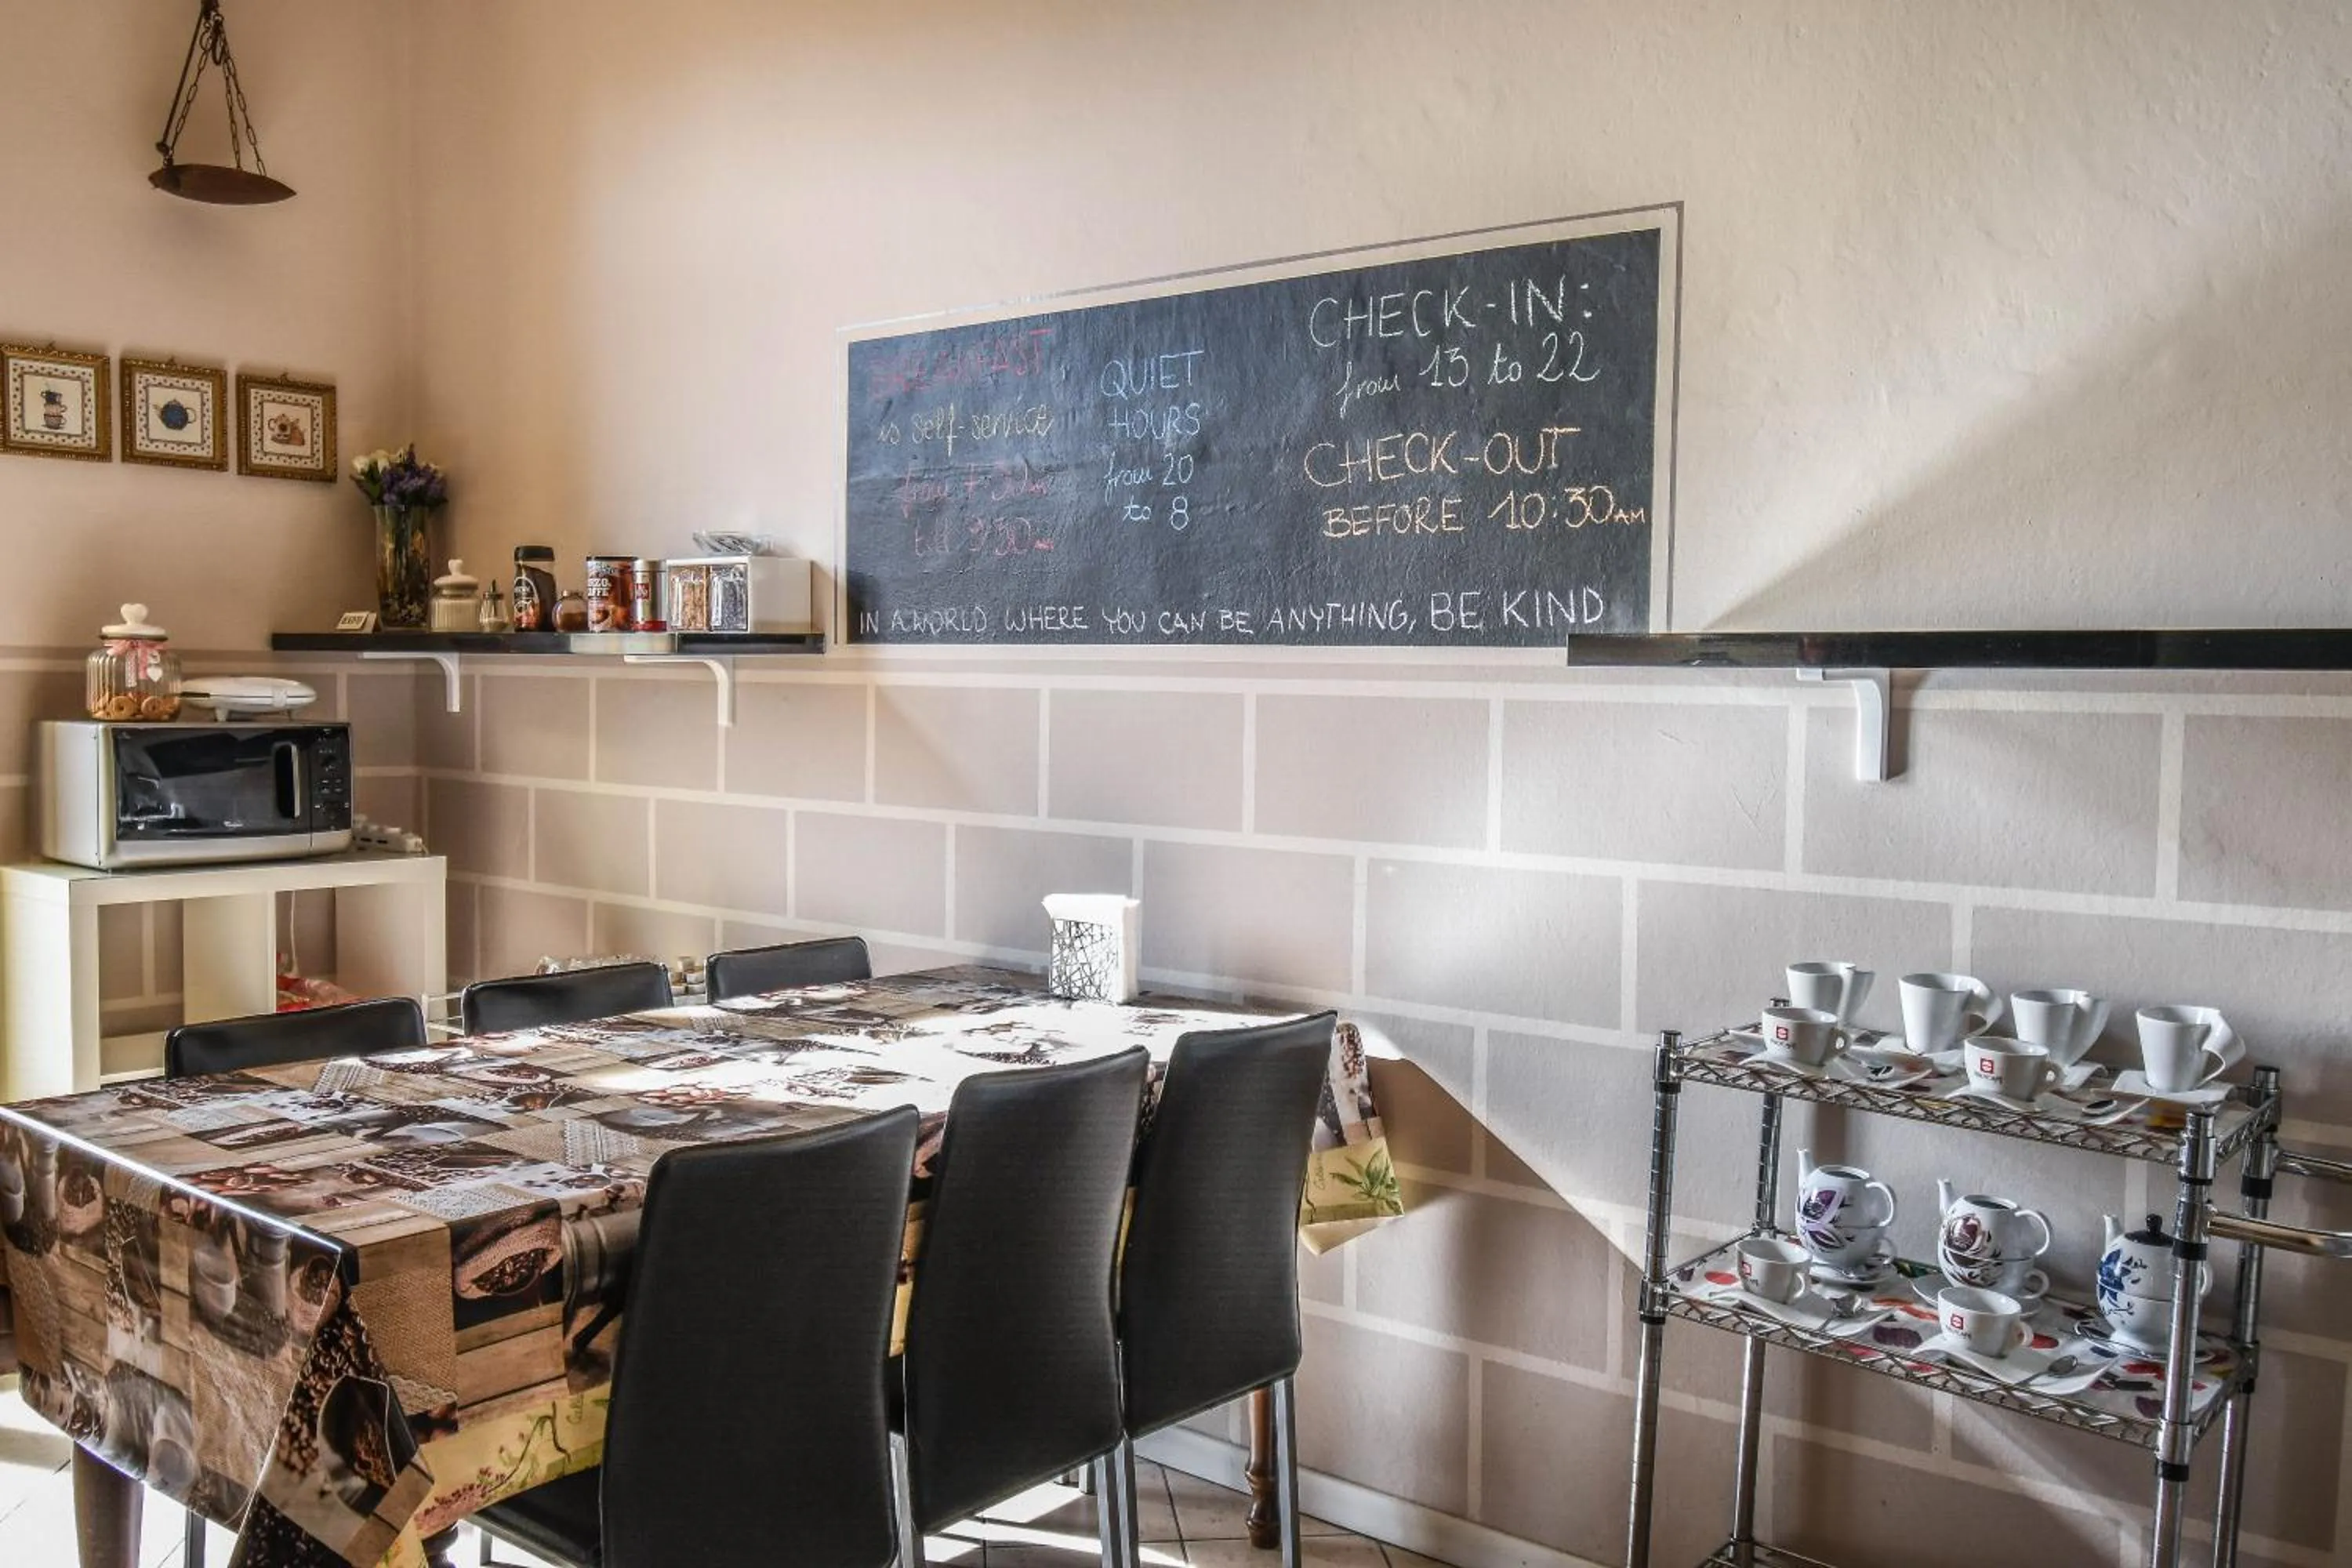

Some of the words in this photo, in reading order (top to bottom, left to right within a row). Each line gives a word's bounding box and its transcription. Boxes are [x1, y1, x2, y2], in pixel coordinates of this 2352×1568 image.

[1308, 274, 1592, 347] CHECK-IN:
[1100, 350, 1205, 401] QUIET
[1335, 361, 1401, 420] from
[1487, 343, 1523, 386] to
[1536, 332, 1601, 383] 22
[1108, 402, 1201, 440] HOURS
[1103, 450, 1154, 507] from
[1162, 452, 1195, 486] 20
[1304, 426, 1581, 488] CHECK-OUT
[1122, 495, 1152, 521] to
[1171, 495, 1189, 531] 8
[1323, 495, 1465, 539] BEFORE
[859, 610, 880, 635] IN
[913, 605, 989, 636] WORLD
[1005, 605, 1088, 633] WHERE
[1102, 606, 1147, 635] YOU
[1158, 610, 1208, 635] CAN
[1219, 608, 1255, 635] BE
[1266, 599, 1417, 633] ANYTHING,
[1430, 591, 1483, 631] BE
[1502, 586, 1606, 627] KIND
